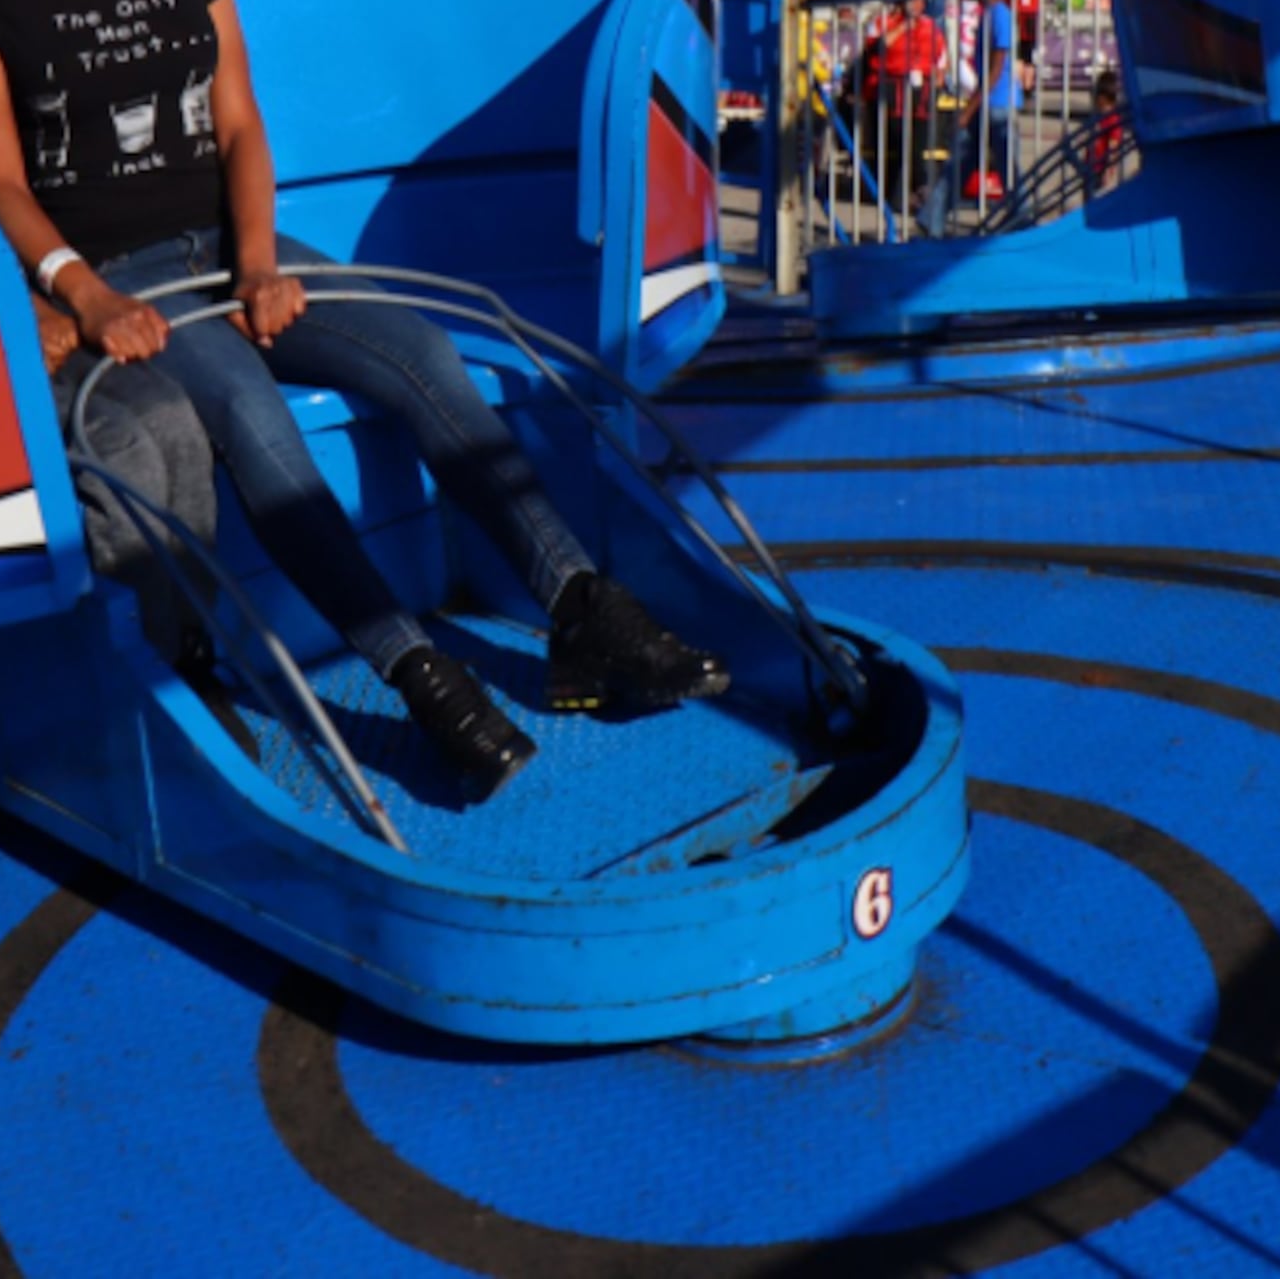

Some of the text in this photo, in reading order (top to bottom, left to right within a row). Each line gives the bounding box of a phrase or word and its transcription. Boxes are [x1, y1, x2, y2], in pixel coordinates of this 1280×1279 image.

[53, 10, 102, 31] The
[94, 20, 151, 45] Men
[851, 866, 895, 941] 6
